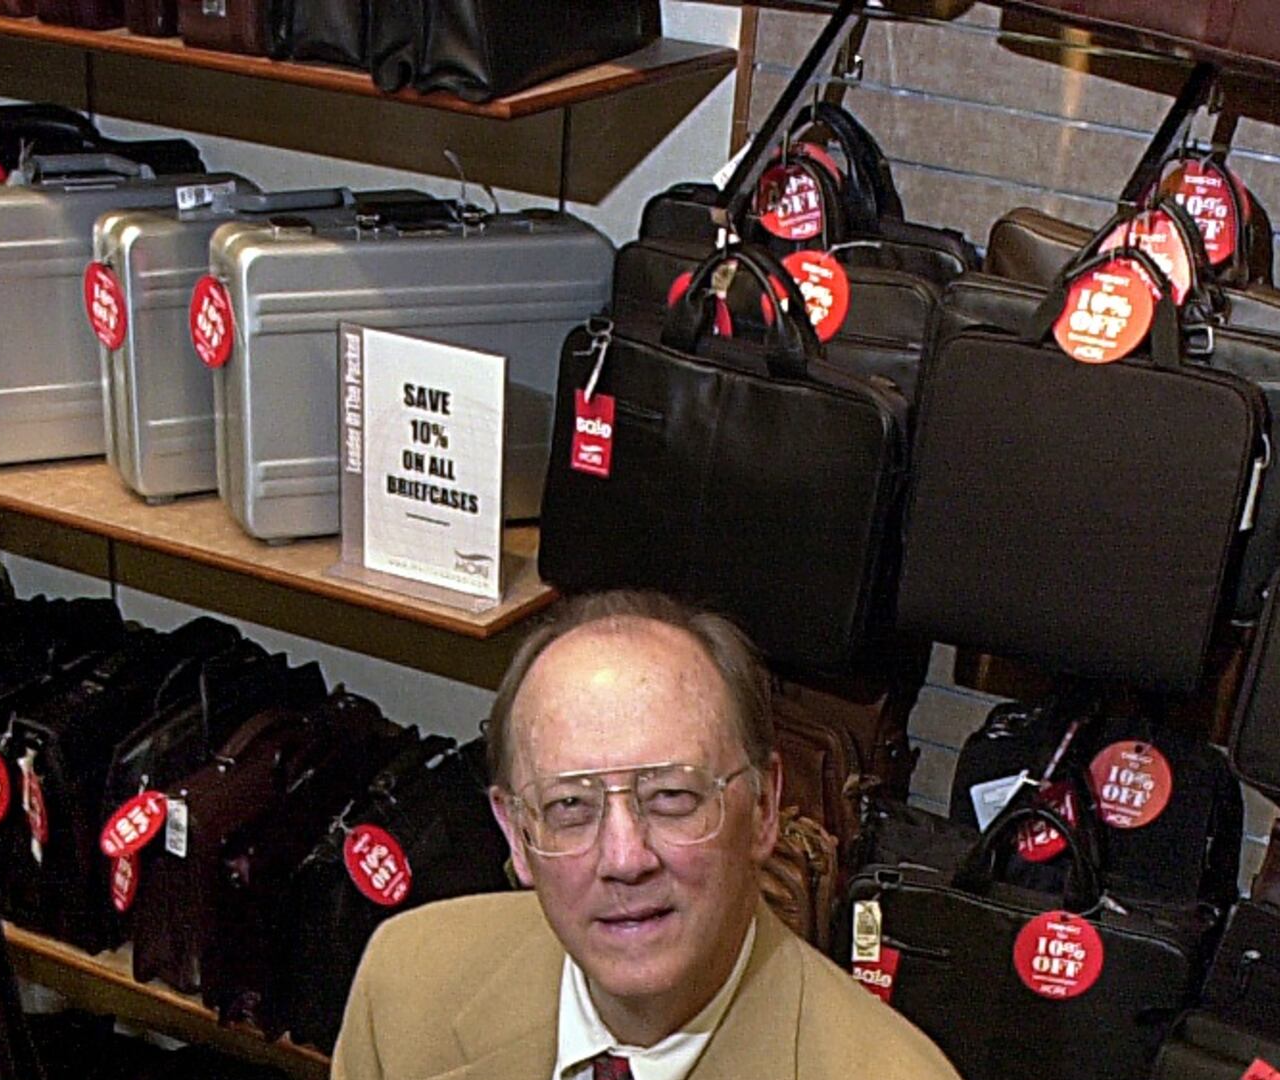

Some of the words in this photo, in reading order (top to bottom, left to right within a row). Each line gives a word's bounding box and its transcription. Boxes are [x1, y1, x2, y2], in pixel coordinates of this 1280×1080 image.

[1078, 288, 1132, 318] 10%
[1070, 310, 1127, 338] OFF
[403, 382, 451, 415] SAVE
[410, 418, 448, 449] 10%
[402, 450, 426, 474] ON
[428, 454, 456, 481] ALL
[386, 475, 479, 514] BRIEFCASES
[1108, 765, 1154, 791] 10%
[1102, 784, 1151, 807] OFF
[1038, 936, 1086, 961] 10%
[1032, 955, 1084, 977] OFF
